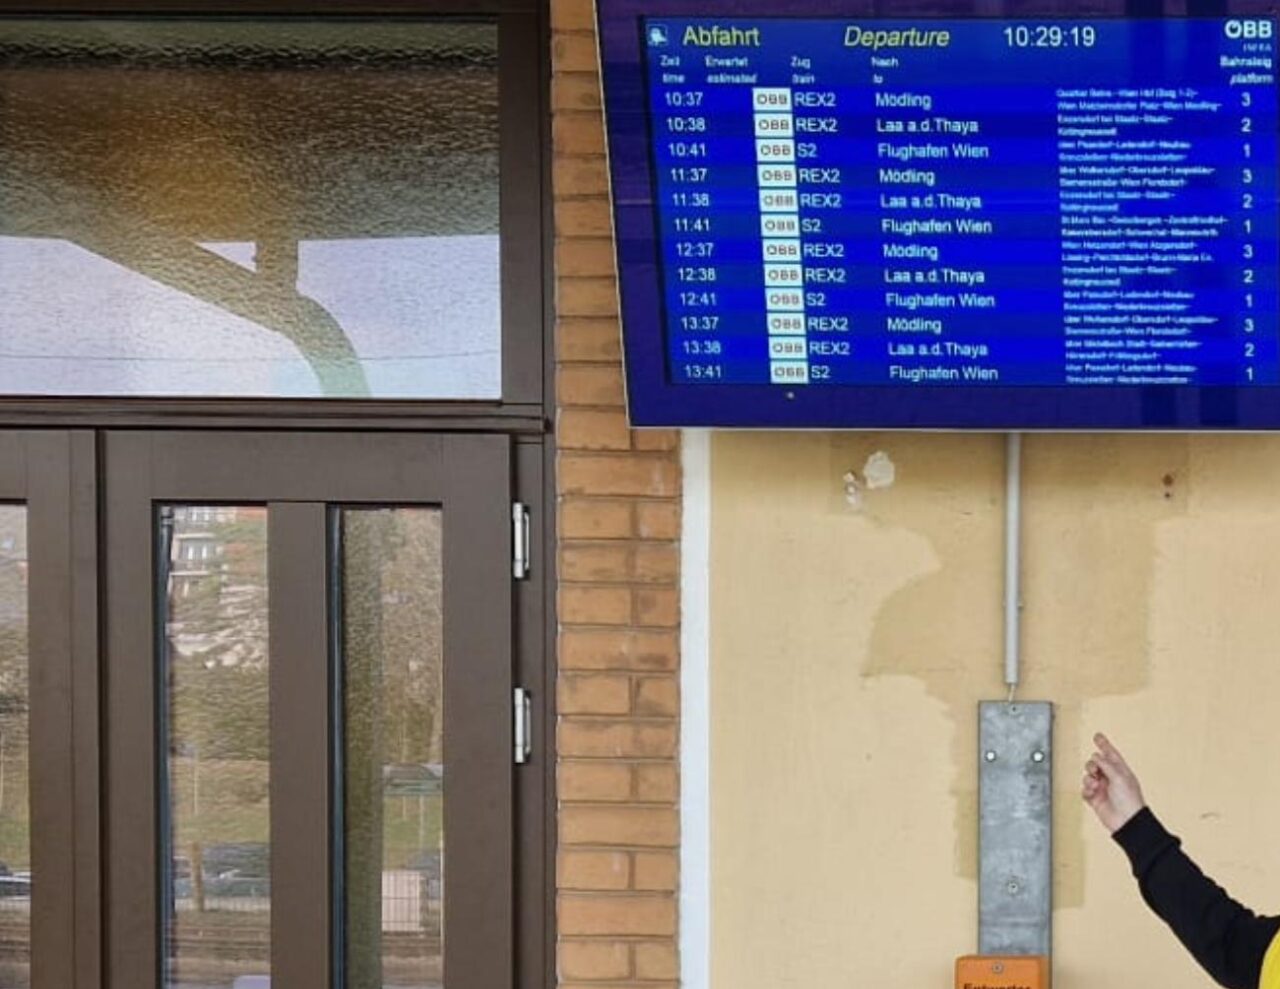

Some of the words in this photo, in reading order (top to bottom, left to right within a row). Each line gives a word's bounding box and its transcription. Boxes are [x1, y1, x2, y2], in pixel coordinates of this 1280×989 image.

[683, 26, 759, 46] Abfahrt
[845, 26, 949, 50] Departure
[1005, 27, 1095, 46] 10:29:19
[791, 56, 810, 68] Zug
[872, 57, 898, 66] Nach
[874, 75, 883, 83] to
[666, 92, 703, 106] 10:37
[794, 92, 835, 106] REX2
[1242, 92, 1250, 106] 3
[667, 118, 705, 131] 10:38
[796, 118, 837, 132] REX2
[877, 118, 903, 132] Laa
[1242, 118, 1250, 132] 2
[669, 143, 705, 156] 10:41
[797, 143, 816, 157] S2
[878, 143, 948, 160] Flughafen
[953, 144, 988, 157] Wien
[1243, 144, 1251, 157] 1
[671, 168, 707, 181] 11:37
[799, 169, 840, 182] REX2
[1243, 169, 1252, 183] 3
[673, 193, 709, 206] 11:38
[800, 194, 840, 207] REX2
[881, 194, 907, 207] Laa
[1243, 194, 1252, 208] 2
[675, 219, 709, 230] 11:41
[802, 219, 821, 232] S2
[882, 219, 951, 235] Flughafen
[956, 219, 992, 233] Wien
[1244, 220, 1251, 232] 1
[677, 243, 713, 256] 12:37
[804, 244, 843, 257] REX2
[1244, 245, 1253, 258] 3
[679, 268, 716, 281] 12:38
[805, 268, 845, 282] REX2
[885, 269, 911, 282] Laa
[1244, 270, 1253, 283] 2
[681, 293, 715, 305] 12:41
[806, 293, 825, 306] S2
[886, 293, 955, 310] Flughafen
[959, 294, 995, 307] Wien
[1245, 294, 1253, 307] 1
[682, 317, 719, 329] 13:37
[808, 317, 848, 331] REX2
[1245, 319, 1254, 332] 3
[684, 341, 721, 354] 13:38
[809, 342, 849, 354] REX2
[889, 342, 915, 355] Laa
[1245, 343, 1254, 356] 2
[686, 366, 720, 377] 13:41
[811, 366, 829, 378] S2
[890, 366, 959, 382] Flughafen
[962, 367, 998, 379] Wien
[1246, 368, 1253, 380] 1
